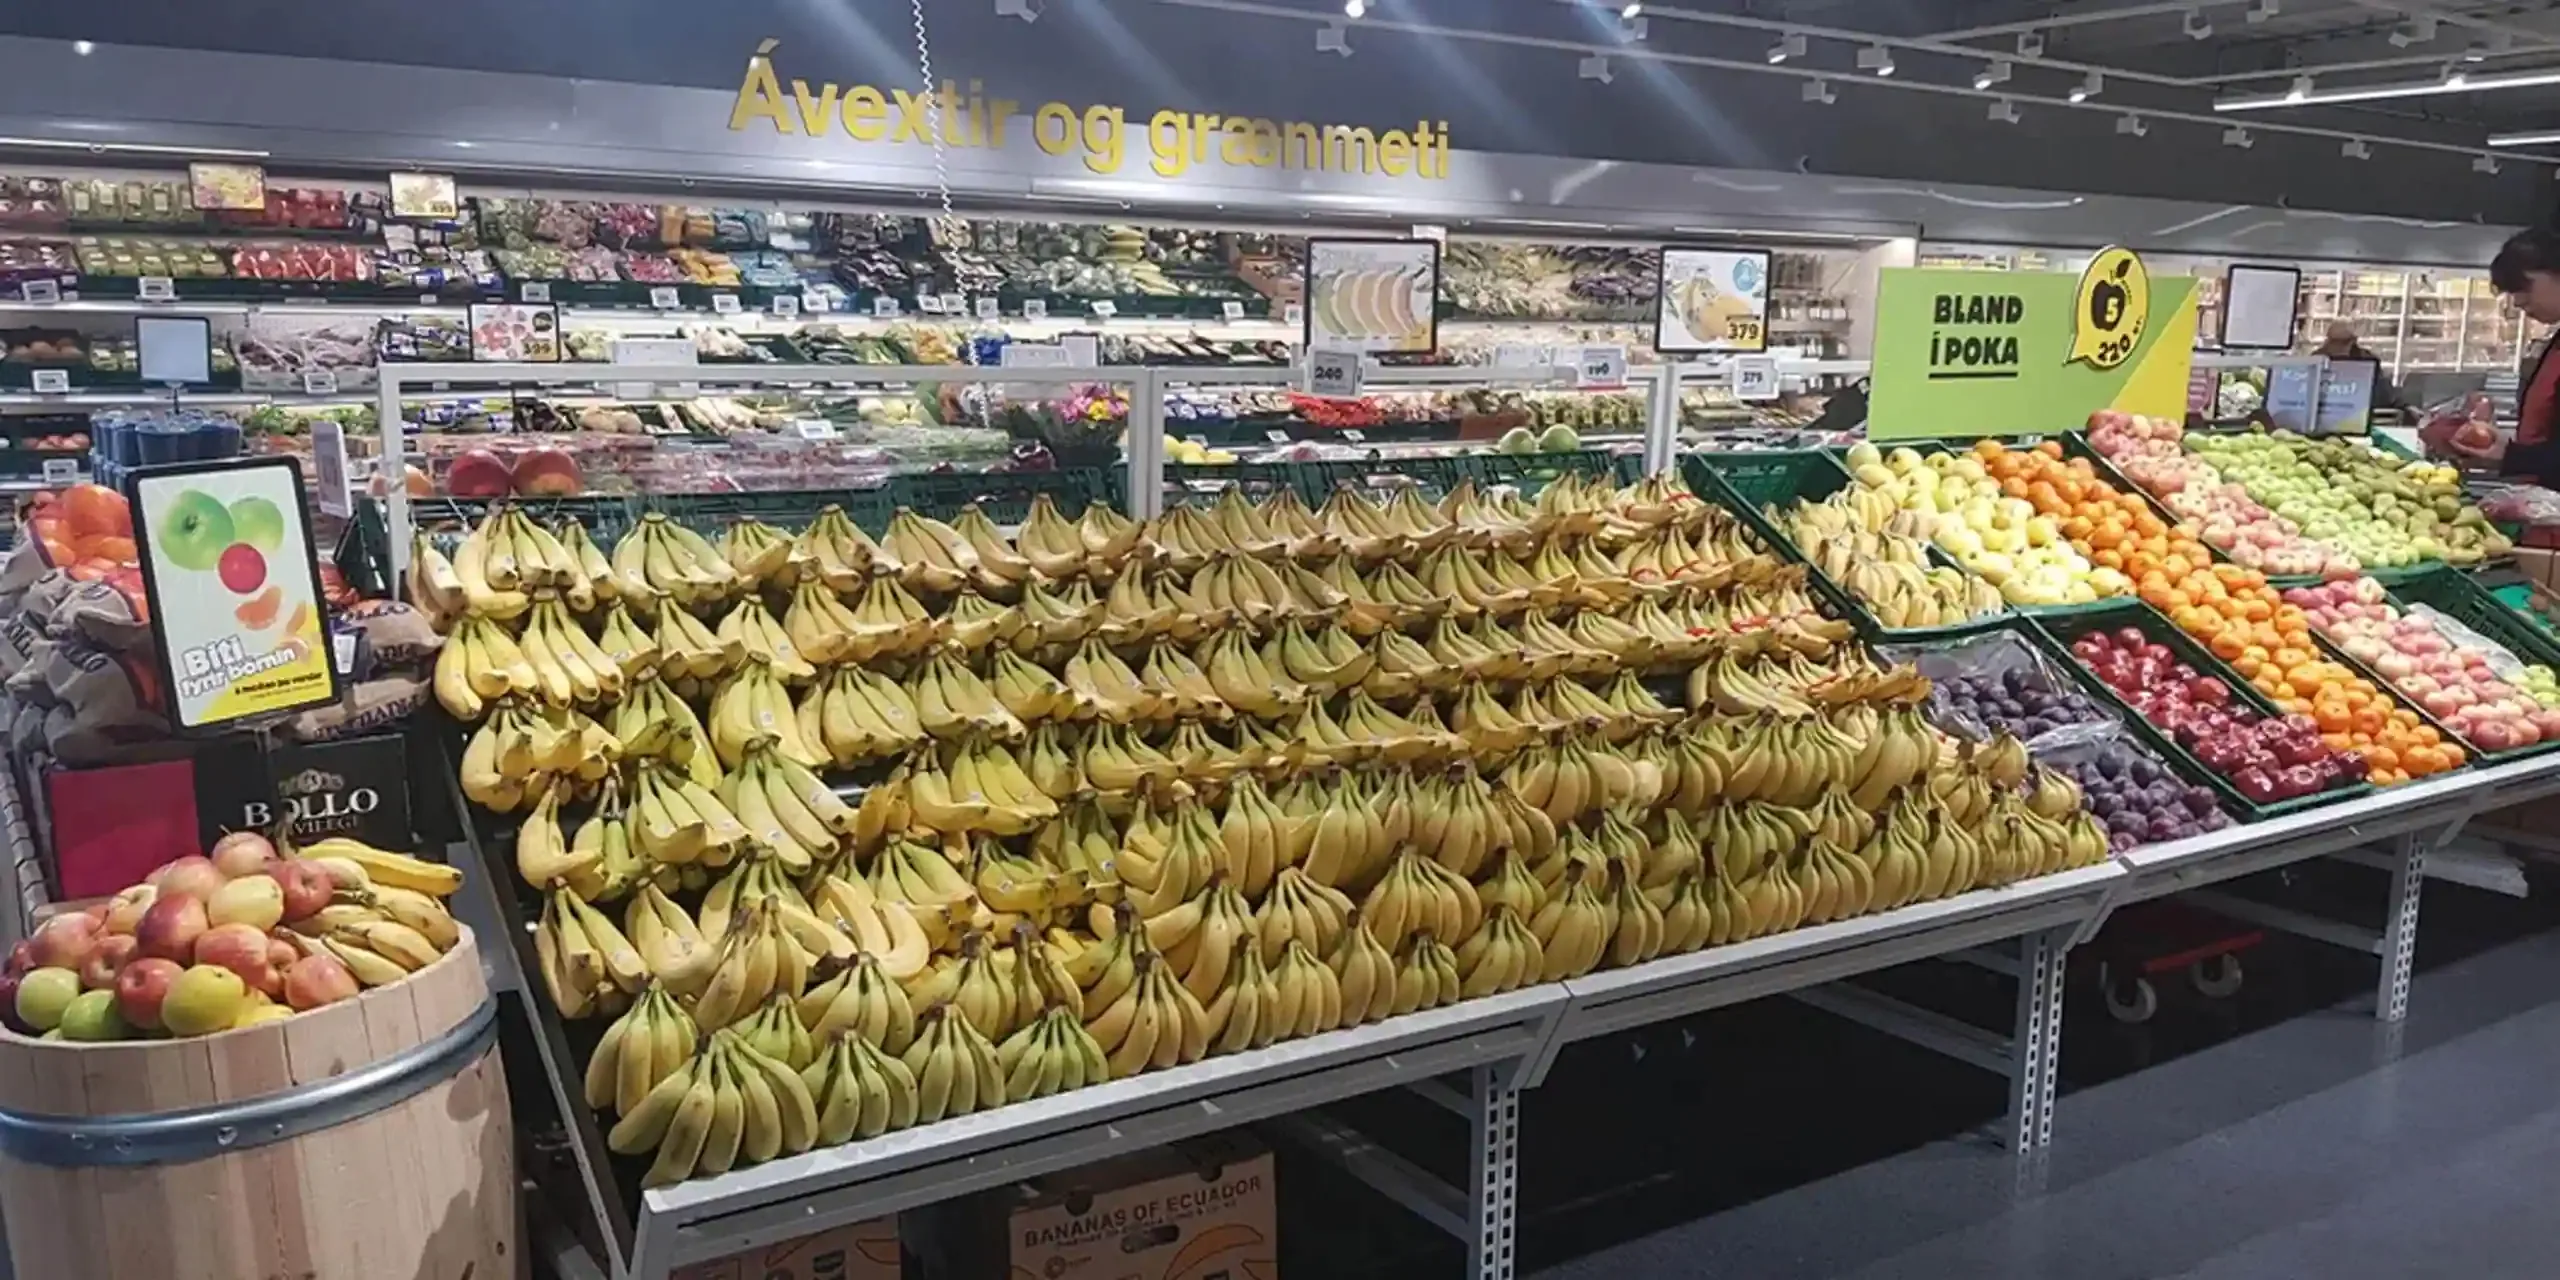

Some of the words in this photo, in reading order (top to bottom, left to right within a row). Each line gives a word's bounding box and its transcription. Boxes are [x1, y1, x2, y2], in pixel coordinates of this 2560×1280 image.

[728, 38, 1019, 147] Ávextir
[1033, 102, 1124, 173] og
[1150, 109, 1450, 179] grænmeti
[1933, 294, 2024, 325] BLAND
[2104, 297, 2119, 323] 5
[1727, 323, 1759, 340] 379
[1929, 331, 1941, 366] Í
[1944, 336, 2019, 366] POKA
[2097, 334, 2130, 361] 220
[1025, 1208, 1127, 1248] BANANAS
[1133, 1201, 1160, 1222] OF
[1165, 1175, 1262, 1213] ECUADOR
